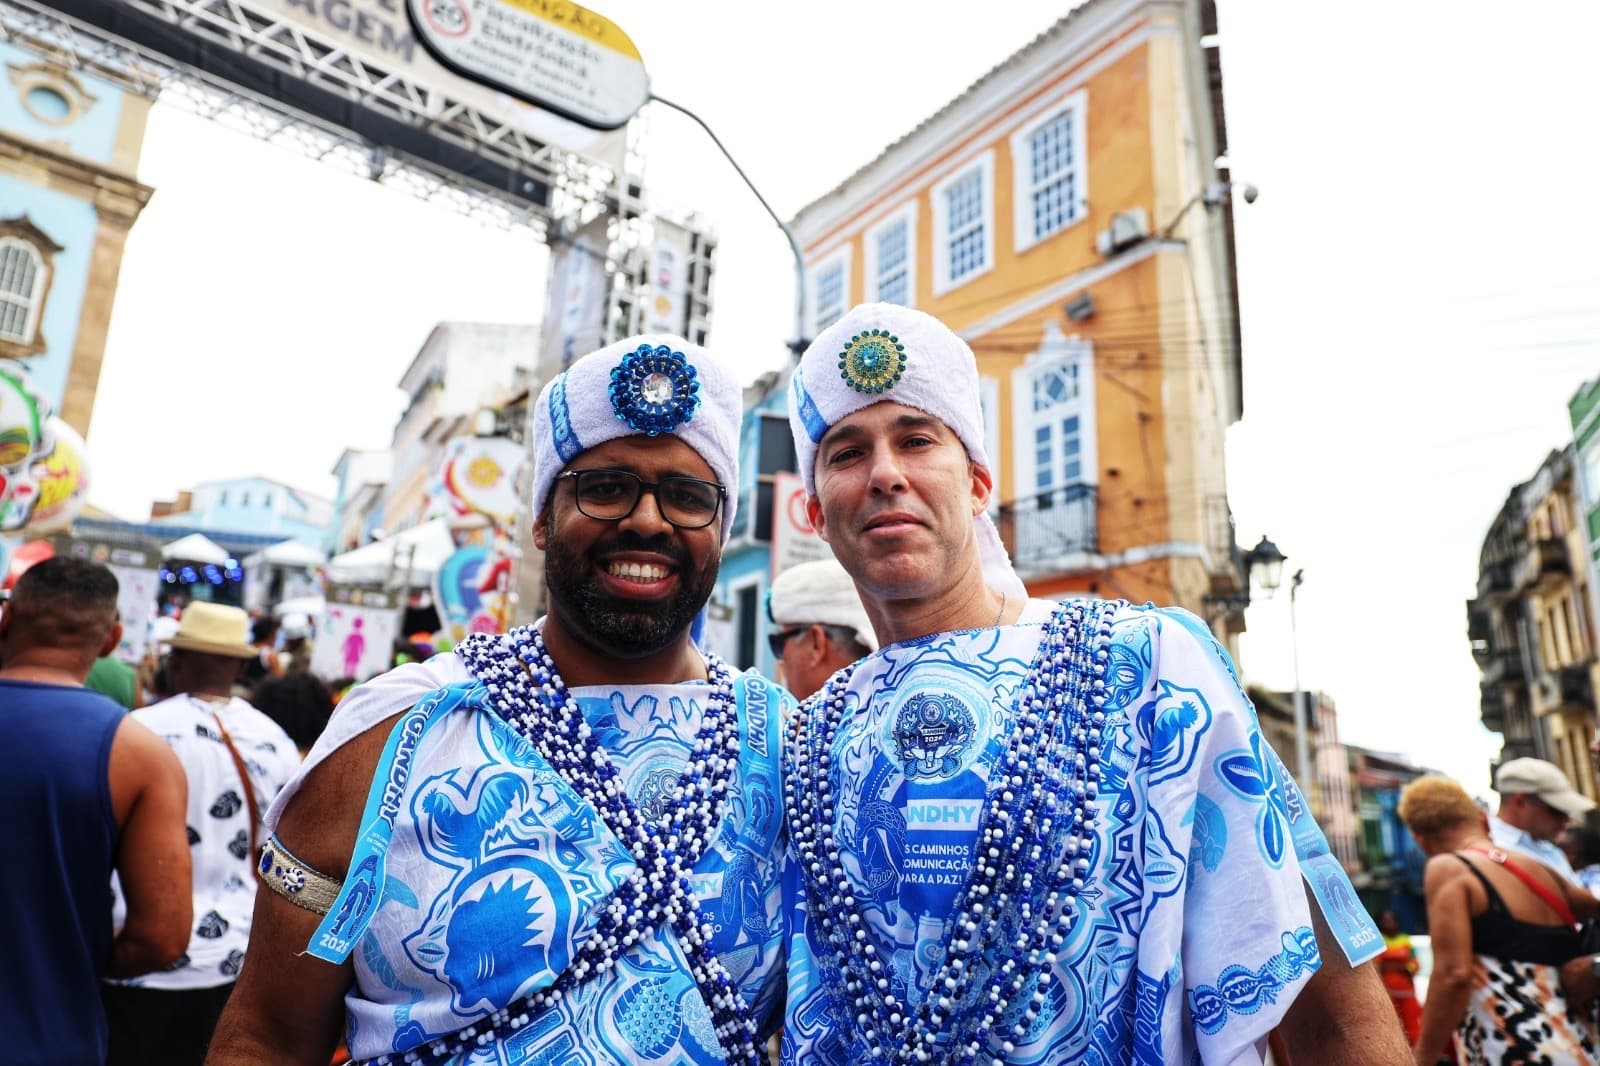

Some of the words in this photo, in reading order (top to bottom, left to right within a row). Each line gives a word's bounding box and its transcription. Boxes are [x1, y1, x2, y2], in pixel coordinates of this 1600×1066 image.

[743, 676, 768, 758] GANDHY
[911, 844, 969, 856] CAMINHOS
[902, 857, 971, 872] OMUNICAÇÃ
[927, 874, 935, 884] A
[937, 874, 962, 885] PAZ!
